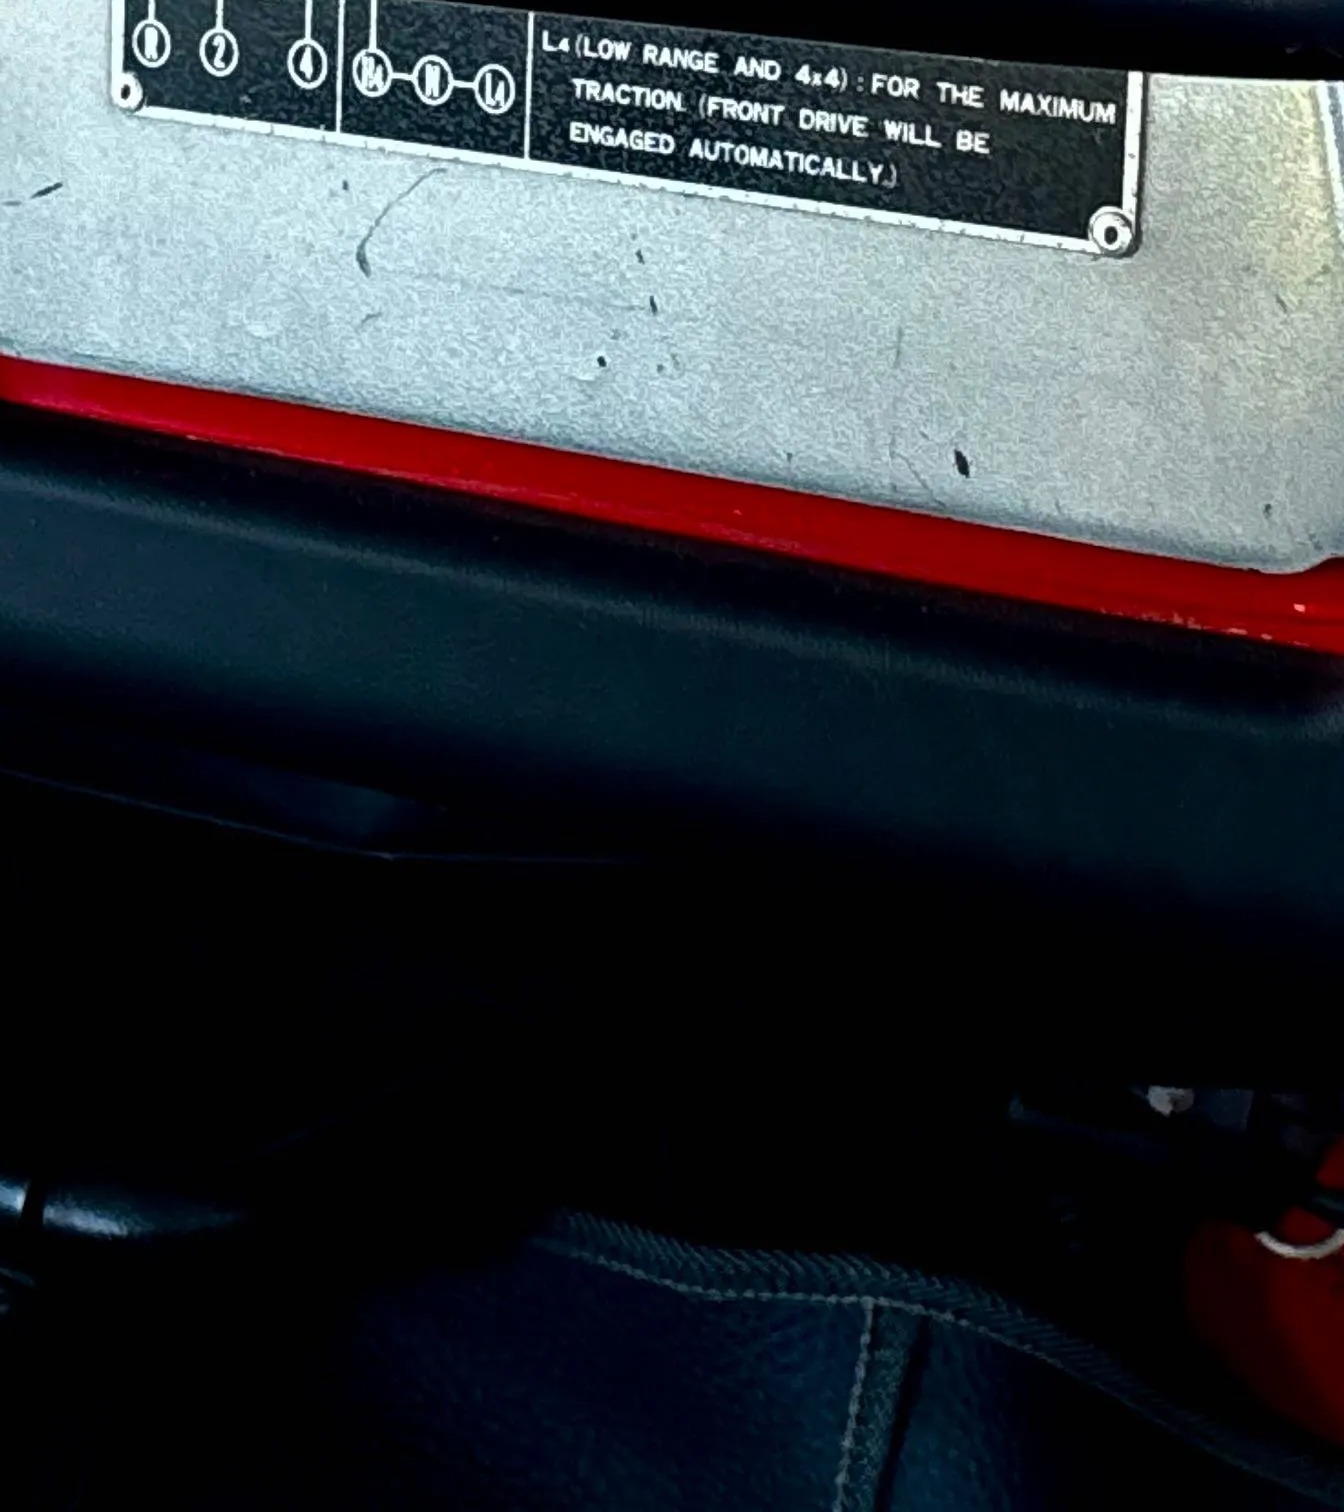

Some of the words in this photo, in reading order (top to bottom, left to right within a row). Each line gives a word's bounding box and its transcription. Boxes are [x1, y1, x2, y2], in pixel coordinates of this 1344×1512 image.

[213, 35, 226, 68] 2
[299, 46, 314, 81] 4
[425, 63, 441, 97] N
[574, 33, 633, 61] (LOW
[643, 44, 720, 74] RANGE
[734, 56, 781, 81] AND
[871, 72, 920, 100] FOR
[936, 81, 985, 109] THE
[1000, 89, 1117, 124] MAXIMUM
[570, 122, 674, 154] ENGAGED
[699, 93, 785, 125] (FRONT
[799, 109, 869, 138] DRIVE
[884, 119, 942, 149] WILL
[956, 130, 990, 154] BE
